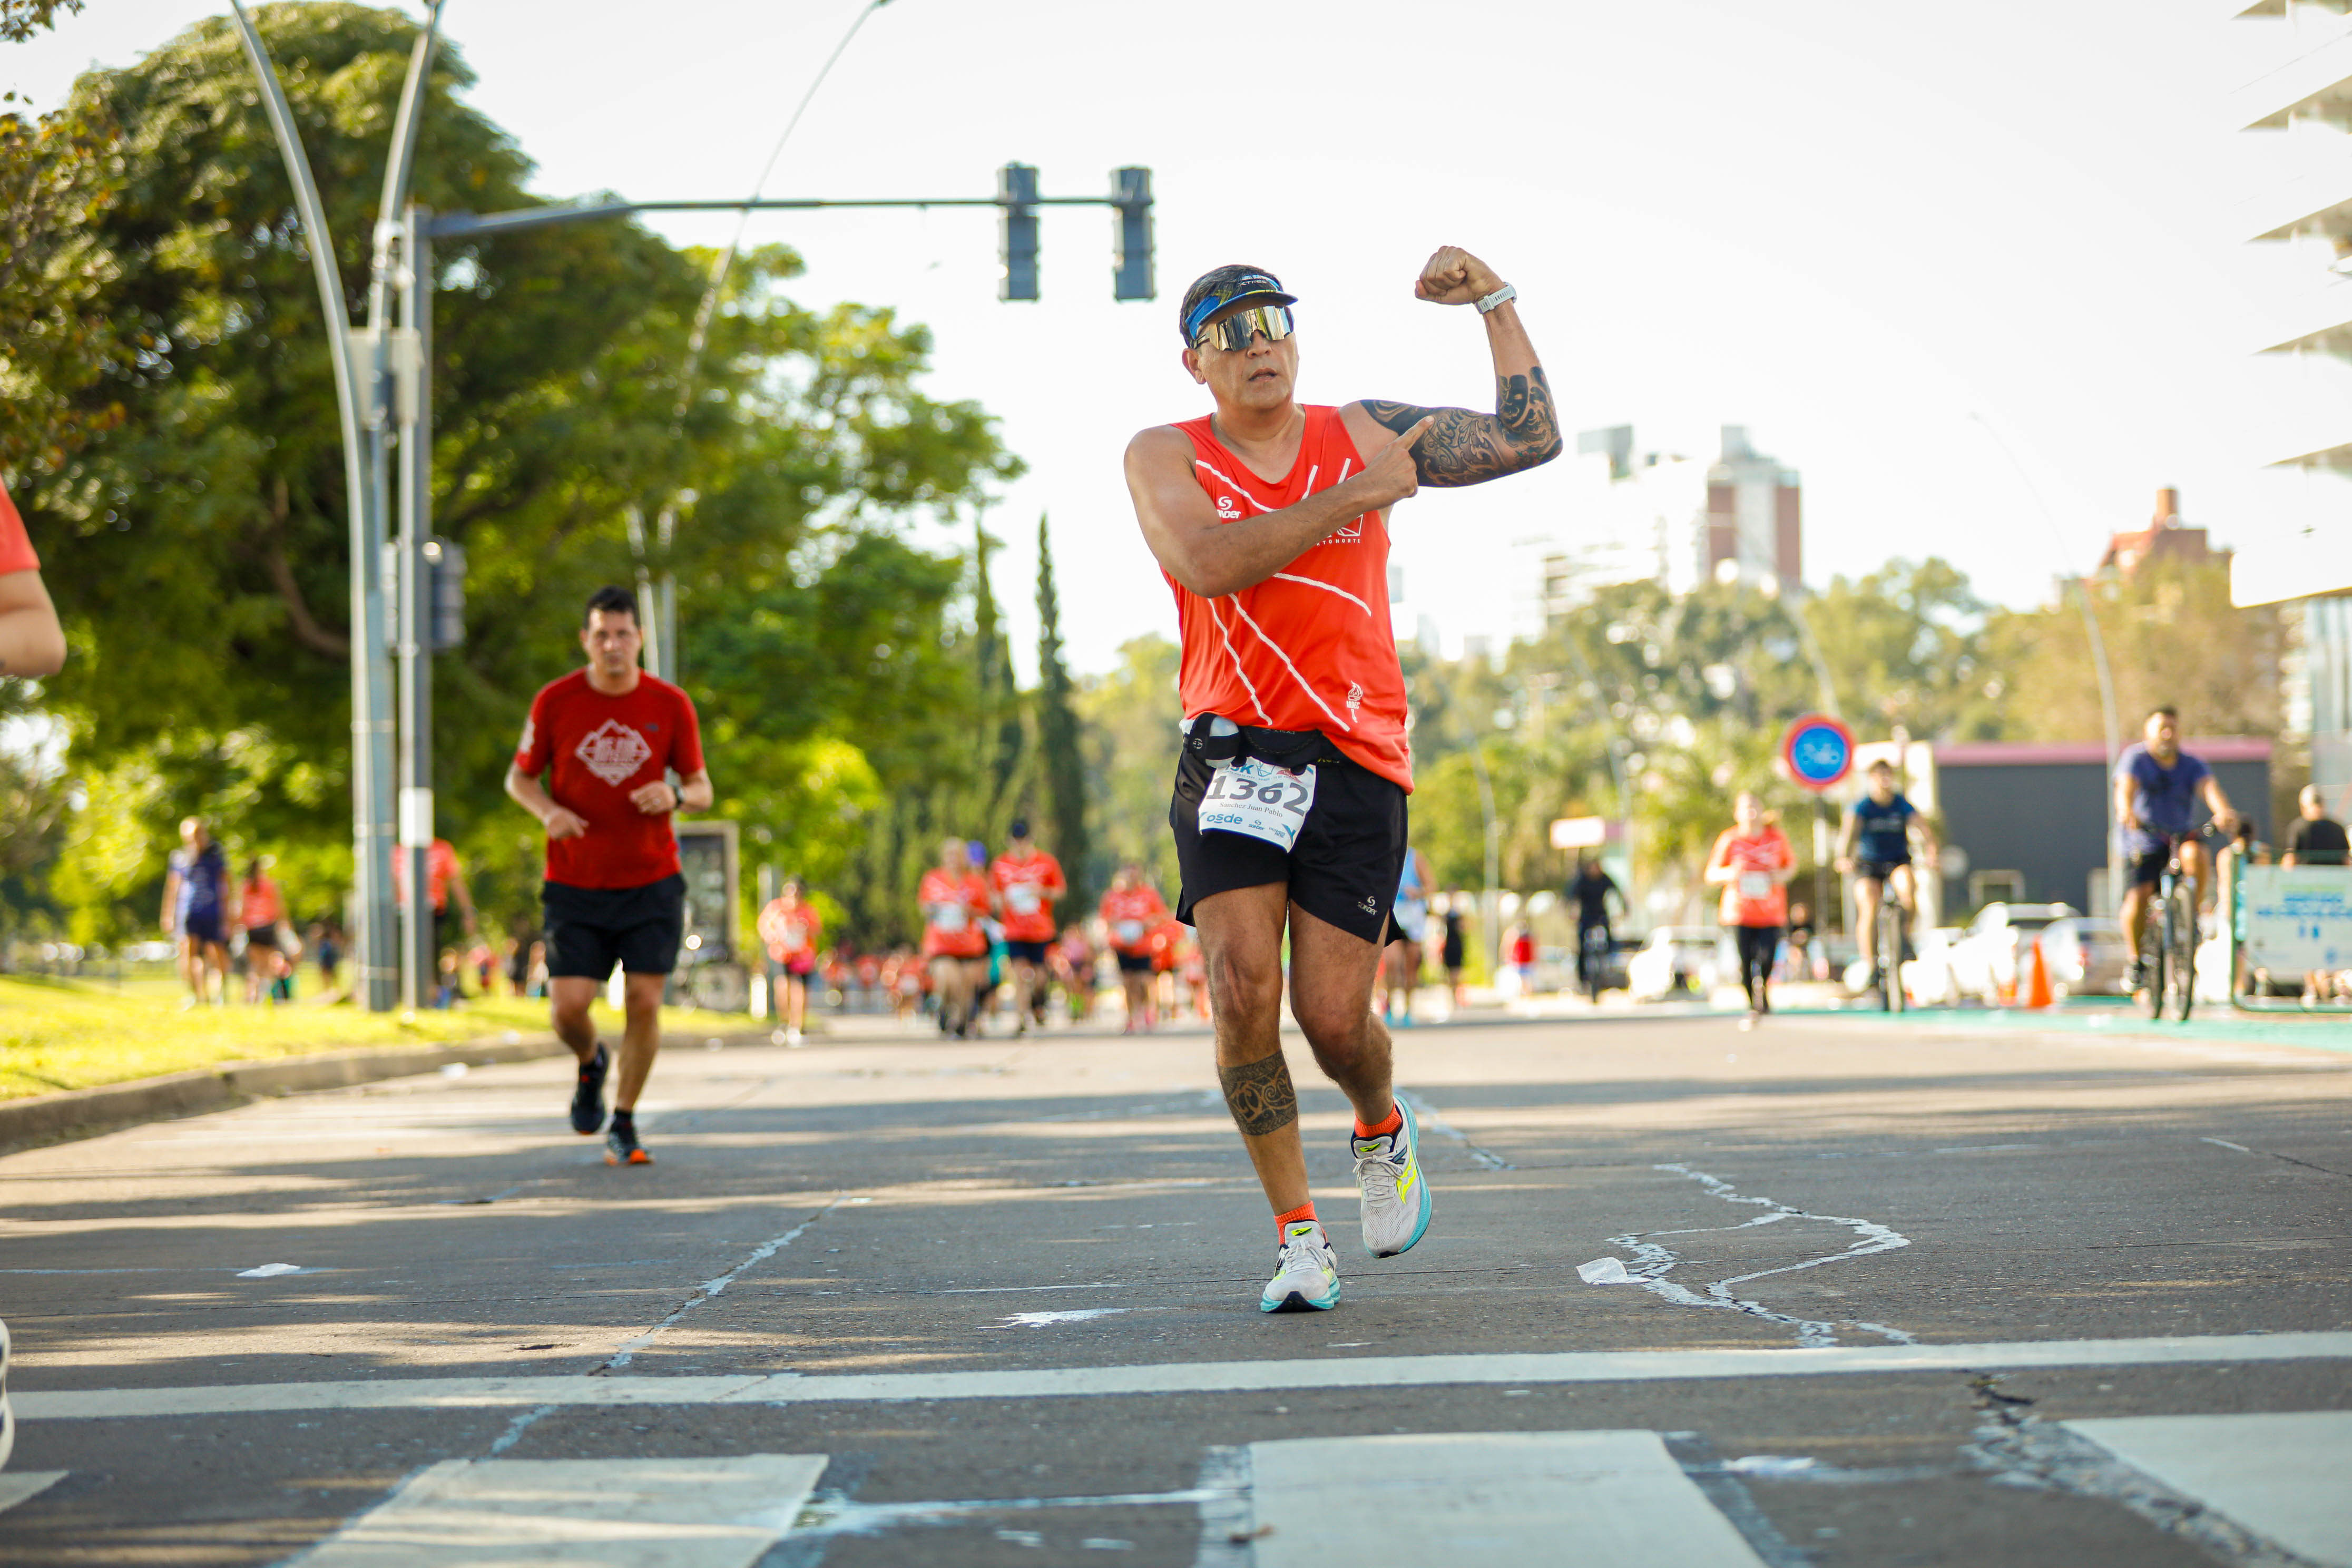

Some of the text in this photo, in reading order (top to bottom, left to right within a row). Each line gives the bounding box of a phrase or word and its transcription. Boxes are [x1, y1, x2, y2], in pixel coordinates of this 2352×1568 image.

[1206, 776, 1308, 817] 1362
[1265, 807, 1283, 818] Pablo
[1207, 813, 1243, 825] osde
